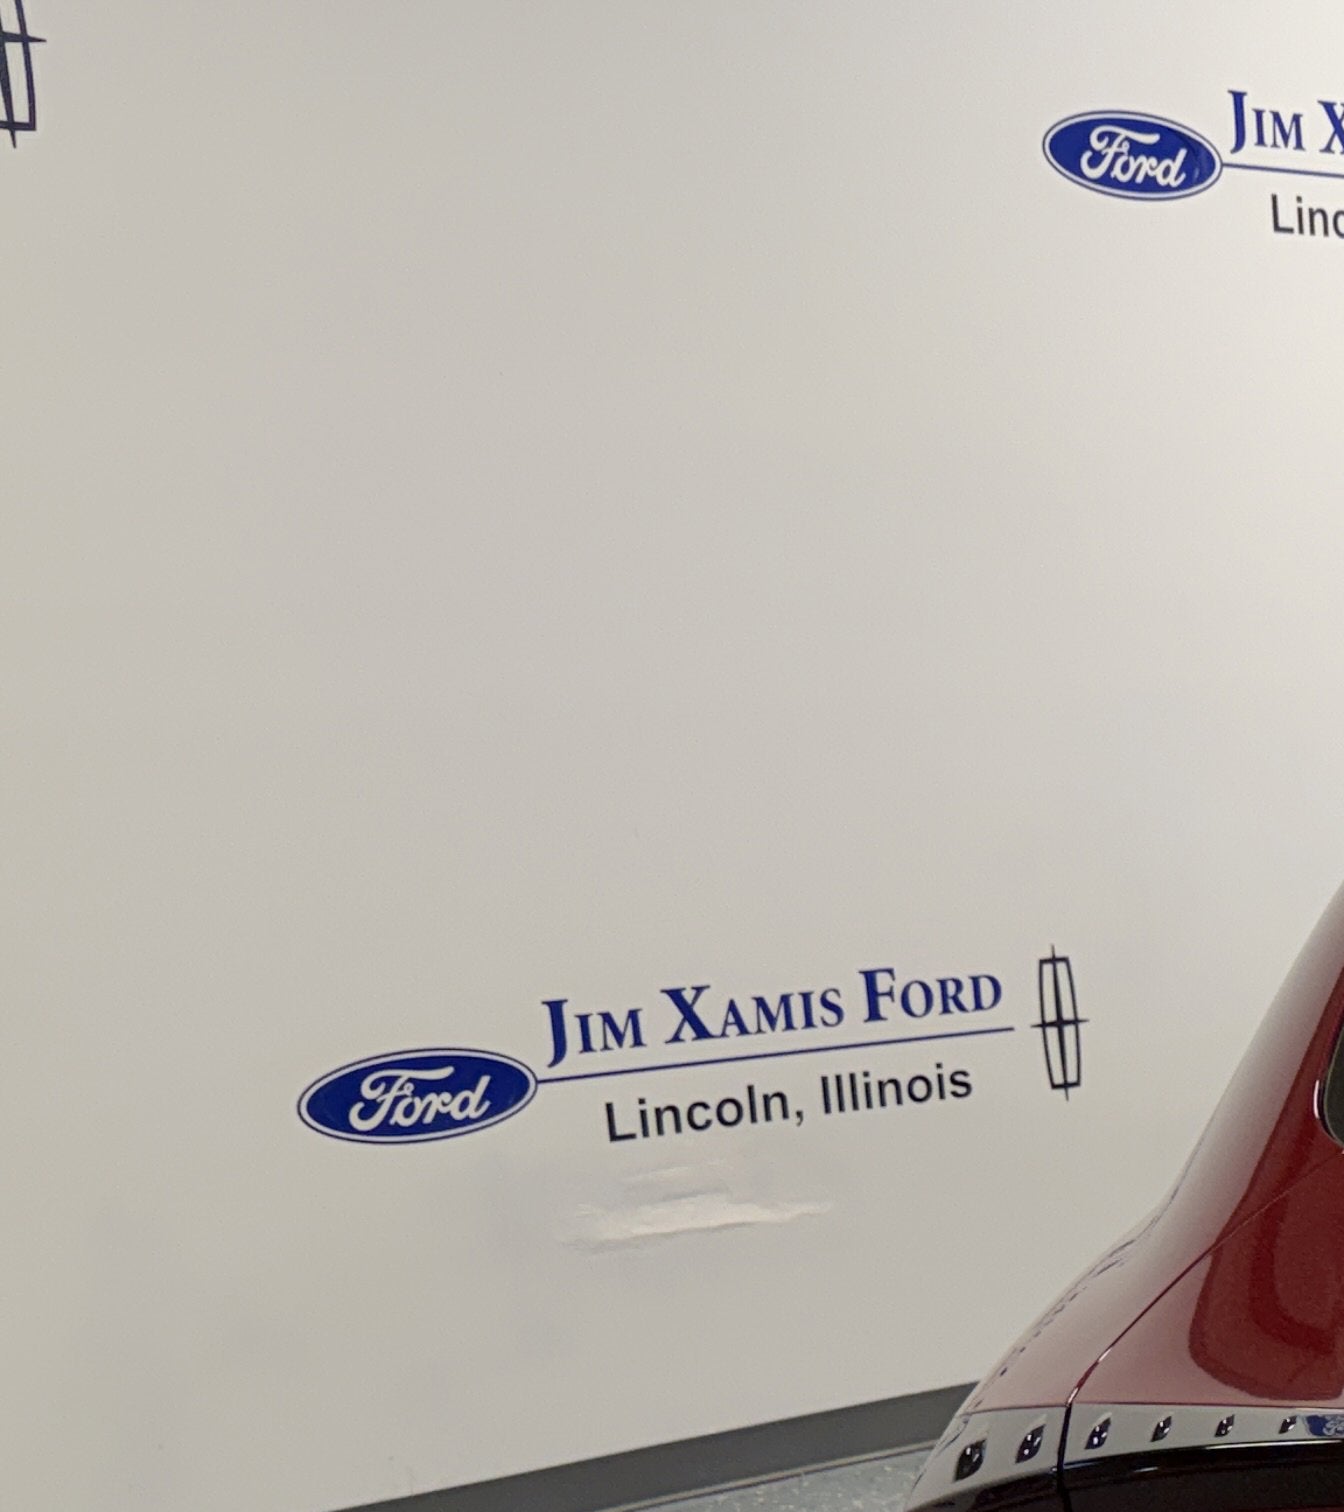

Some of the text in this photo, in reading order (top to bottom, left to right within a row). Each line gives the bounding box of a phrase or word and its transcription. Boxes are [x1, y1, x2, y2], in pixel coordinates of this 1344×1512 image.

[1227, 89, 1305, 155] JIM
[1079, 125, 1187, 188] Ford
[541, 967, 1003, 1068] JIM XAMIS FORD
[348, 1065, 491, 1130] Ford
[605, 1062, 974, 1144] Lincoln, Illinois
